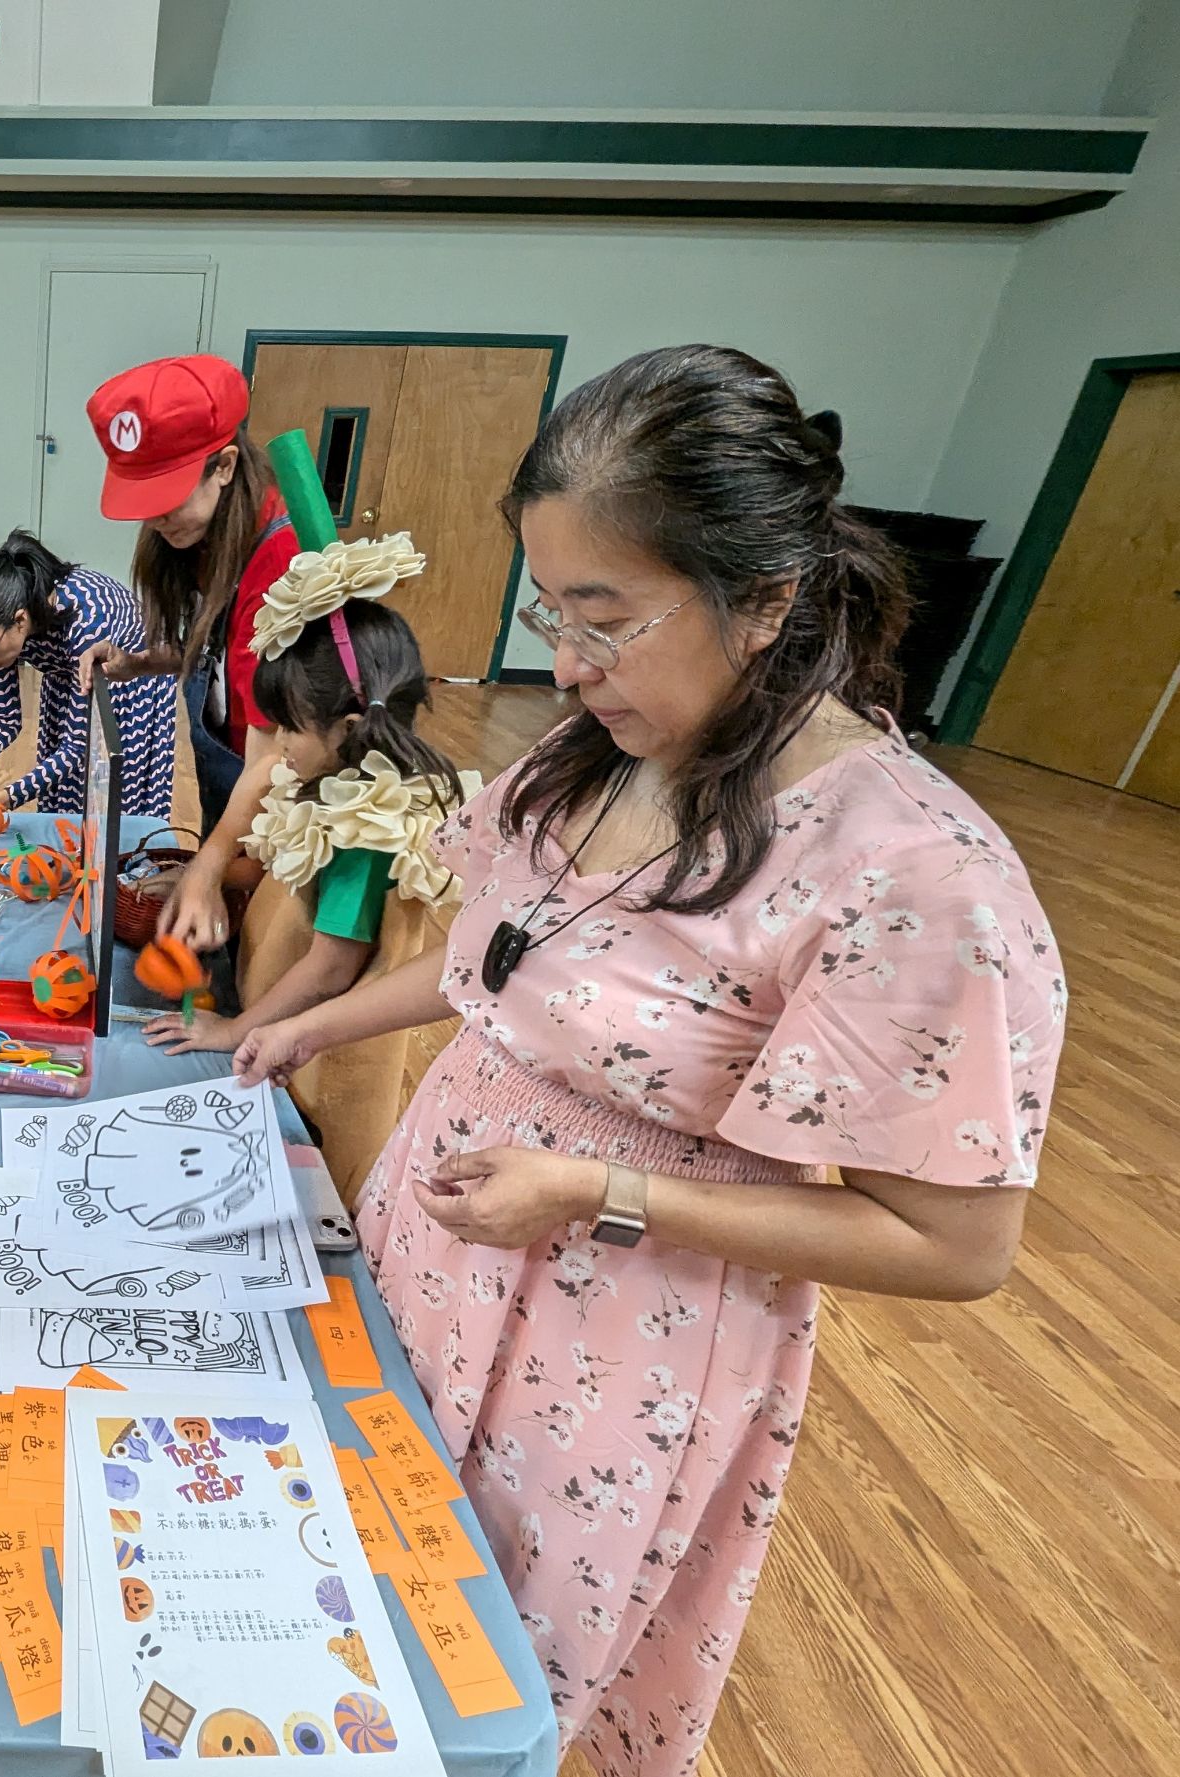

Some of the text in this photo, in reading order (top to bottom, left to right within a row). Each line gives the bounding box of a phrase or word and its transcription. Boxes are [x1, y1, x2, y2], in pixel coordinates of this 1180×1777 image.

[117, 416, 137, 446] M
[57, 1179, 108, 1228] BOO!
[329, 1326, 344, 1340] 四
[21, 1401, 46, 1452] 紫色
[163, 1437, 227, 1467] TRICK
[368, 1414, 430, 1488] 萬聖節
[195, 1463, 223, 1480] OR
[176, 1475, 244, 1504] TREAT
[403, 1574, 456, 1650] 女巫
